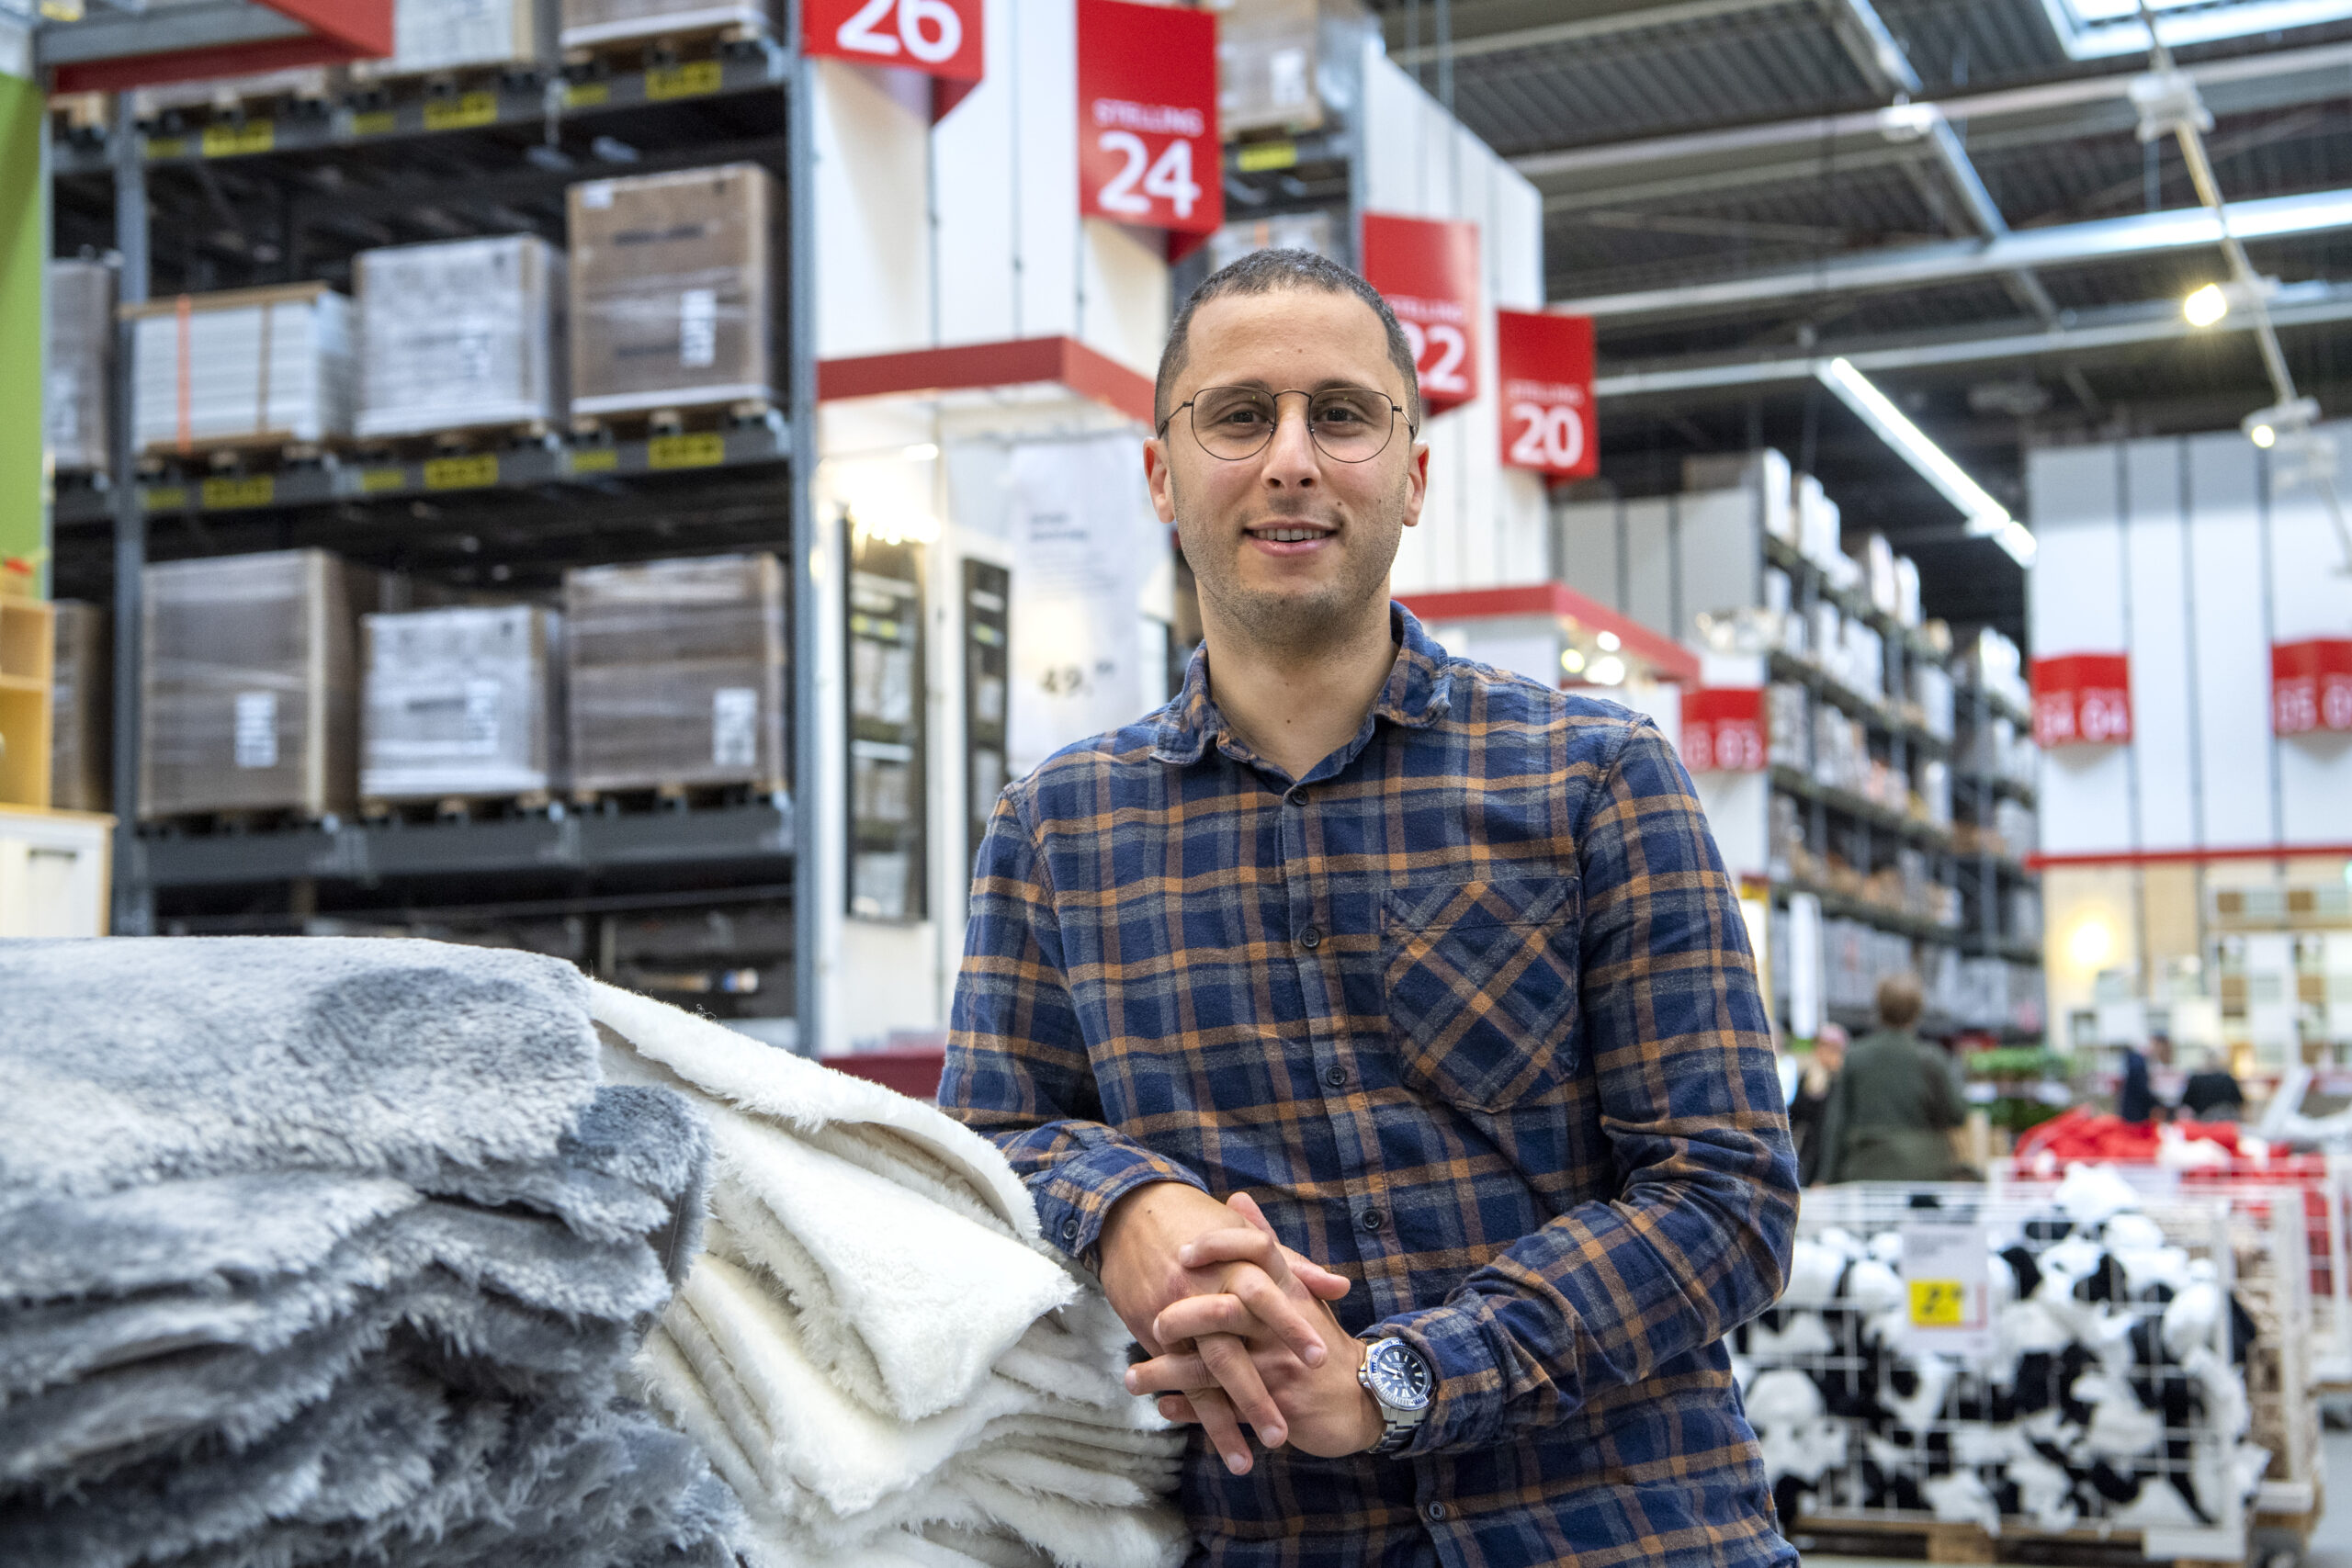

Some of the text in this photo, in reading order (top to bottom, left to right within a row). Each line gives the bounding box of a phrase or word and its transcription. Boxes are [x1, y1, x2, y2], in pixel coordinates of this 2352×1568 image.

[837, 0, 962, 63] 26
[1092, 97, 1204, 137] STELLING
[1098, 130, 1203, 219] 24
[1384, 295, 1464, 322] TELLING
[1510, 401, 1584, 468] 20
